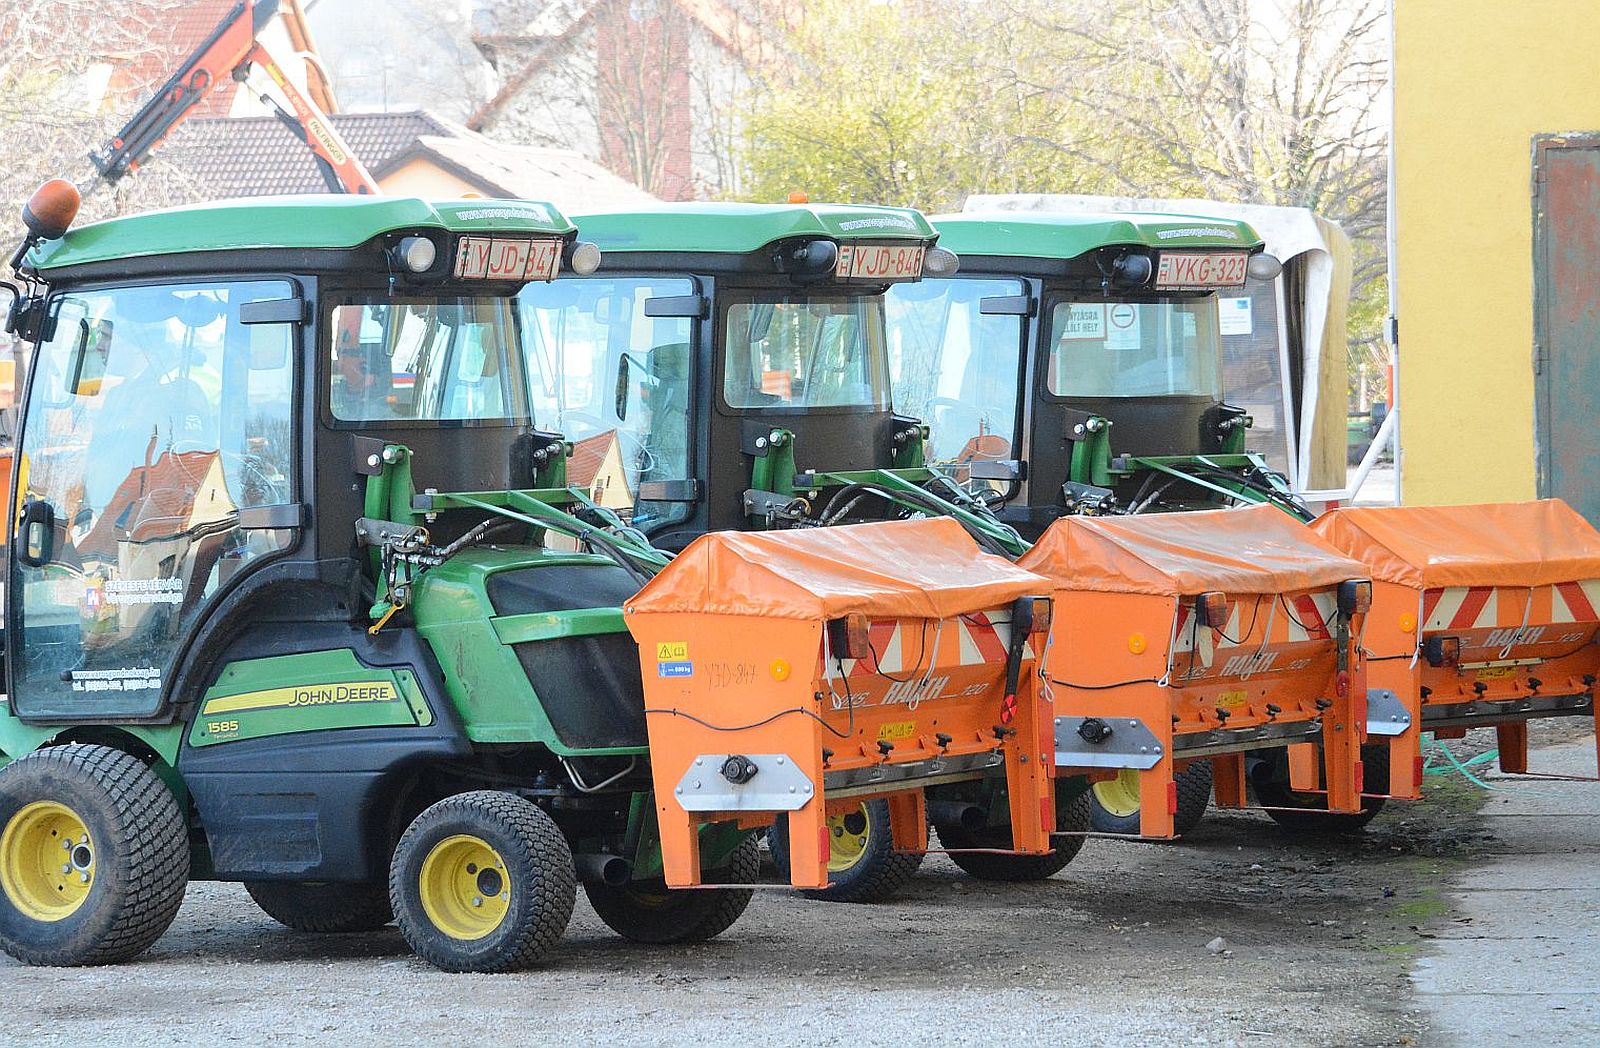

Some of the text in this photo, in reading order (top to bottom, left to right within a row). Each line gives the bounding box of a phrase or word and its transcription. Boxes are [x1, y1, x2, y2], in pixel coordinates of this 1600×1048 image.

[478, 244, 559, 274] YJD-847
[1159, 258, 1245, 282] H YKG-323
[288, 686, 390, 706] JOHN DEERE
[207, 719, 239, 733] 1585
